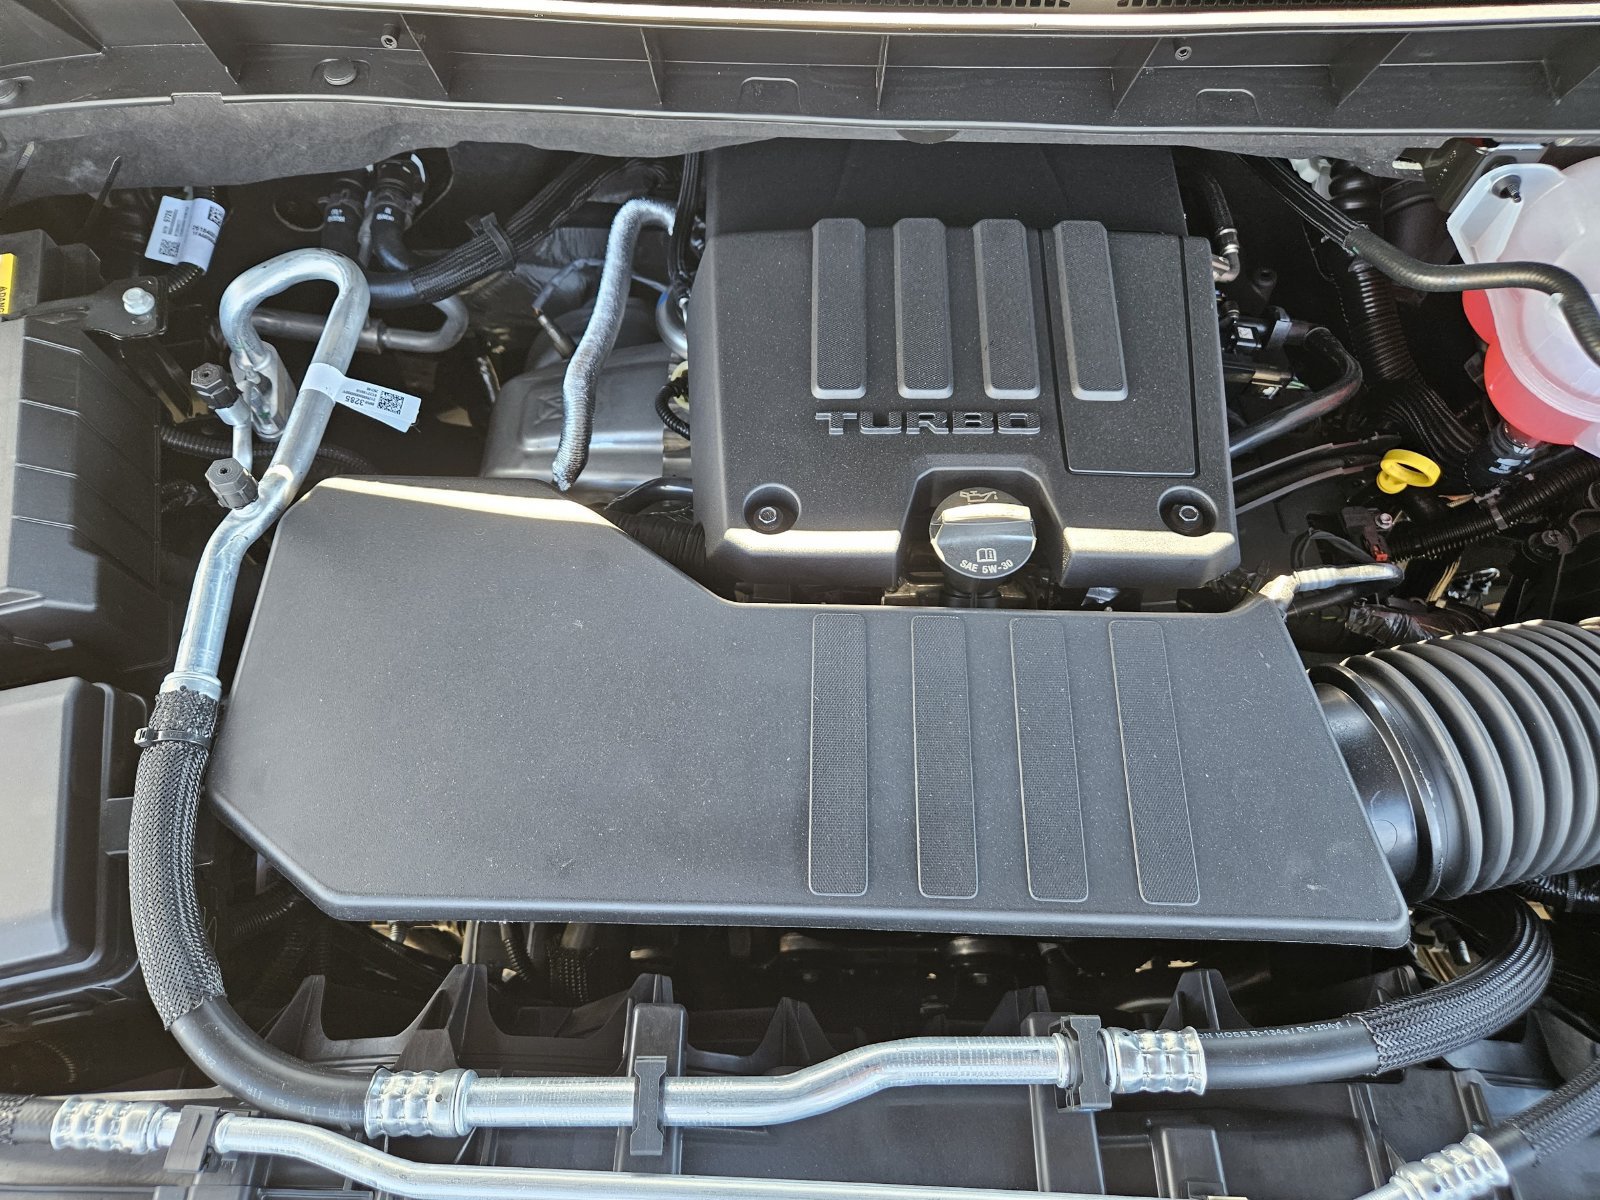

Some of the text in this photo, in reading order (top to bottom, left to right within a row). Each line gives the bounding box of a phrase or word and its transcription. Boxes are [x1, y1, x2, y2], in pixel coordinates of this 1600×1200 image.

[345, 395, 365, 406] 3285
[814, 411, 1041, 434] TURBO
[959, 559, 1014, 574] SAE 5W-30
[1215, 1031, 1249, 1039] HOSE
[1250, 1028, 1289, 1037] R-134a
[1296, 1021, 1342, 1034] R-1234yf
[272, 1096, 289, 1110] PET
